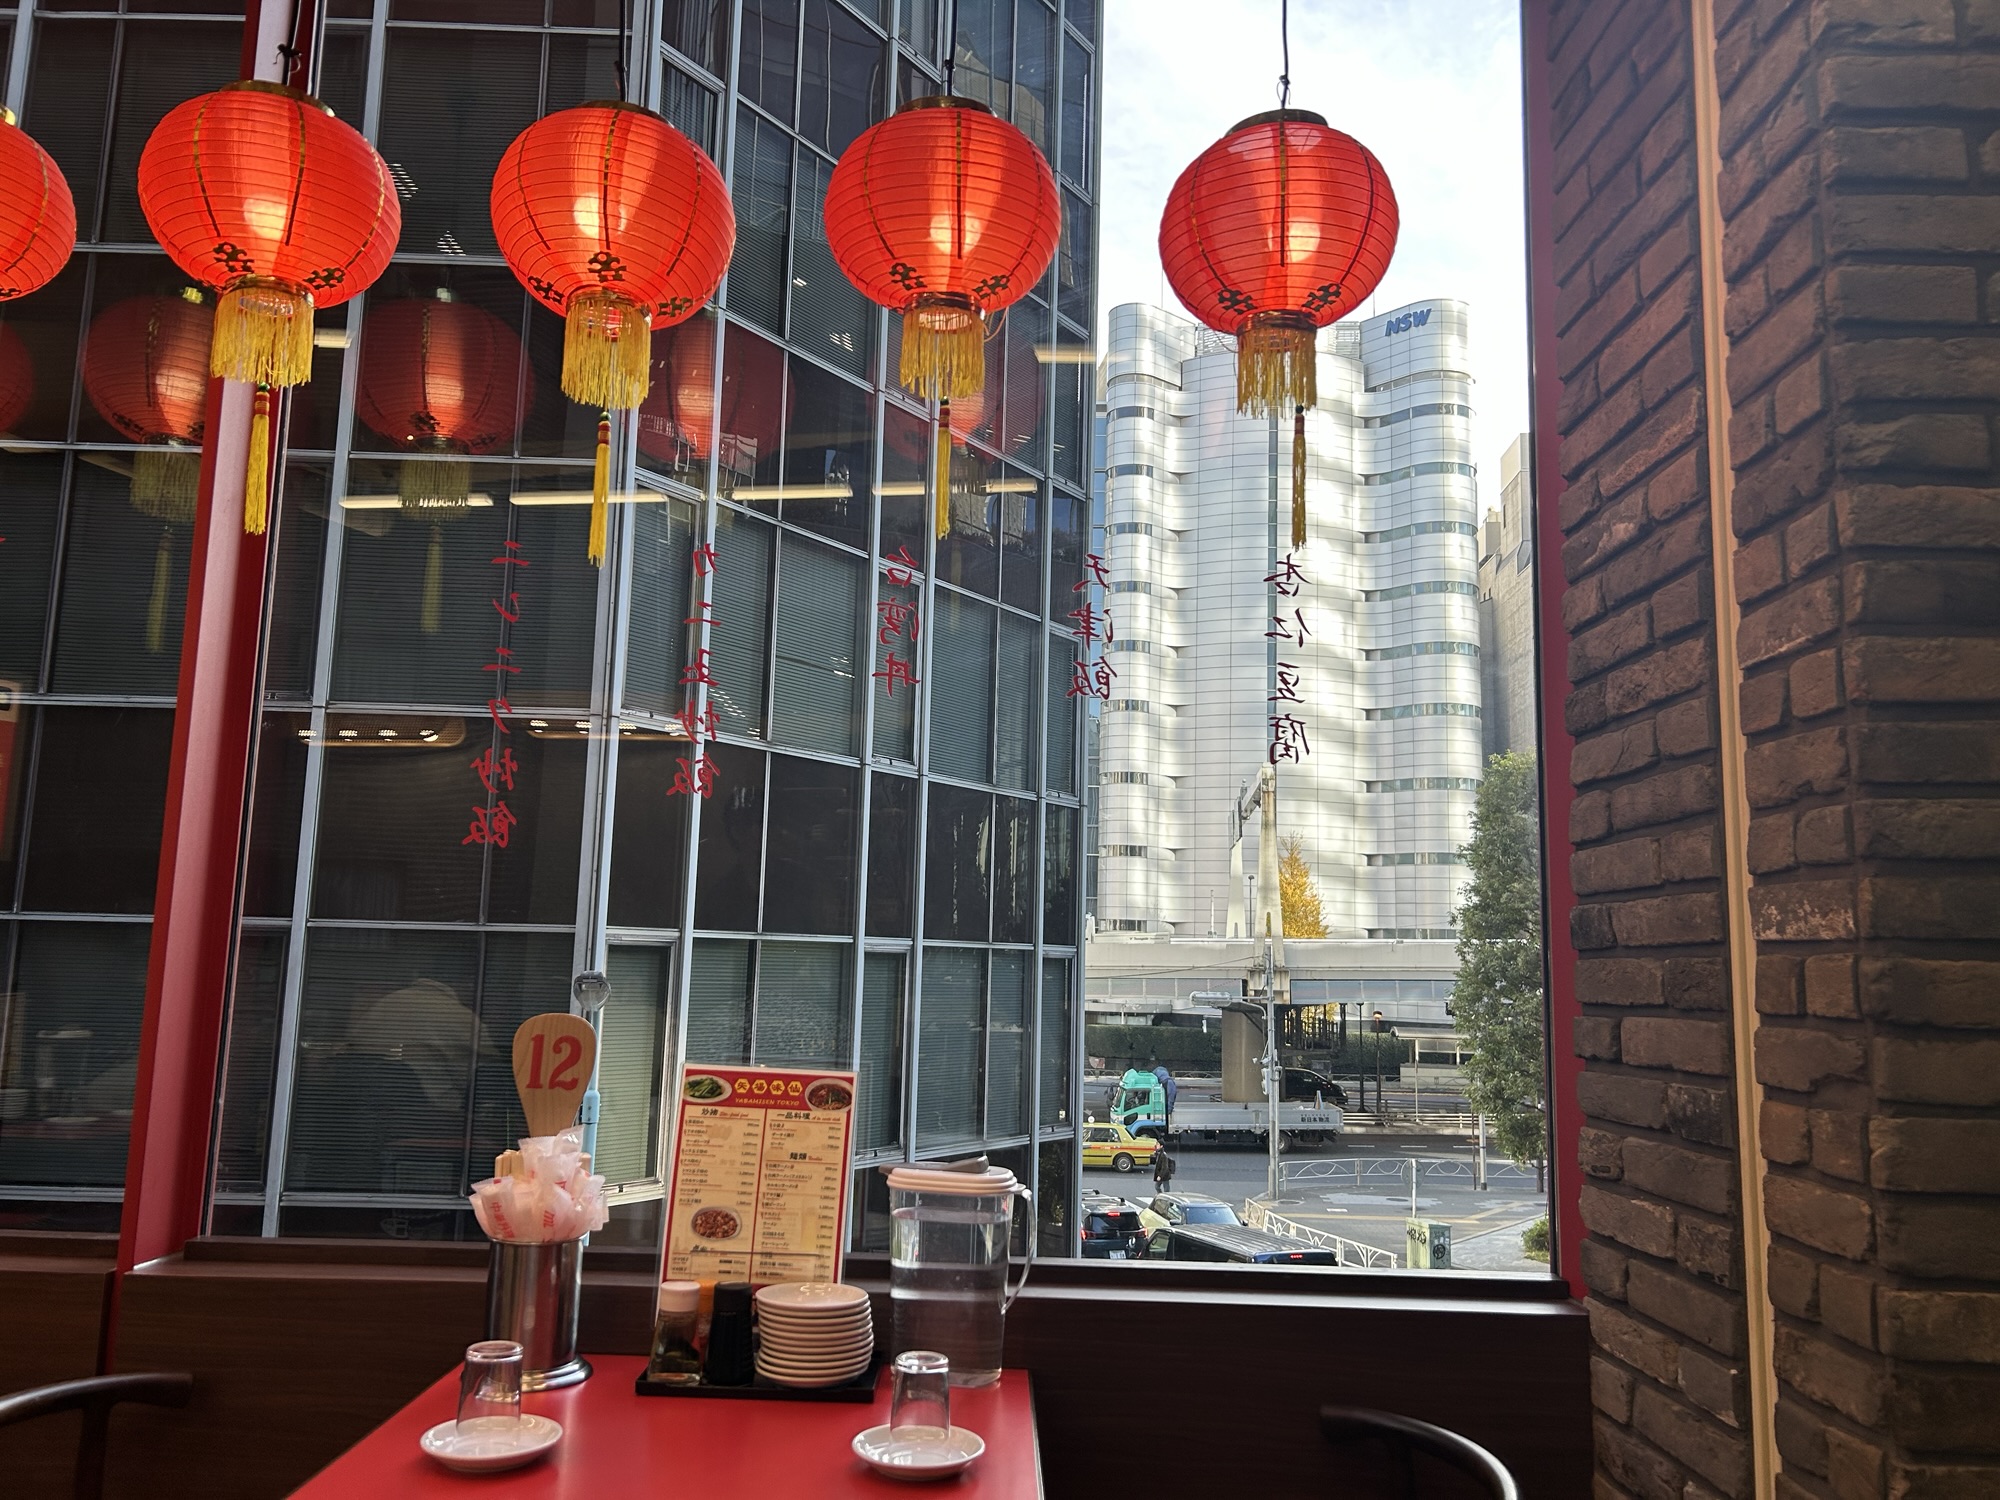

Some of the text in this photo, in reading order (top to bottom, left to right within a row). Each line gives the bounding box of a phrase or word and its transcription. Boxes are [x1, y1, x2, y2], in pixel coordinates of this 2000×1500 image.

[1384, 308, 1432, 337] NSW
[525, 1033, 582, 1091] 12
[777, 1111, 811, 1120] 一品料理
